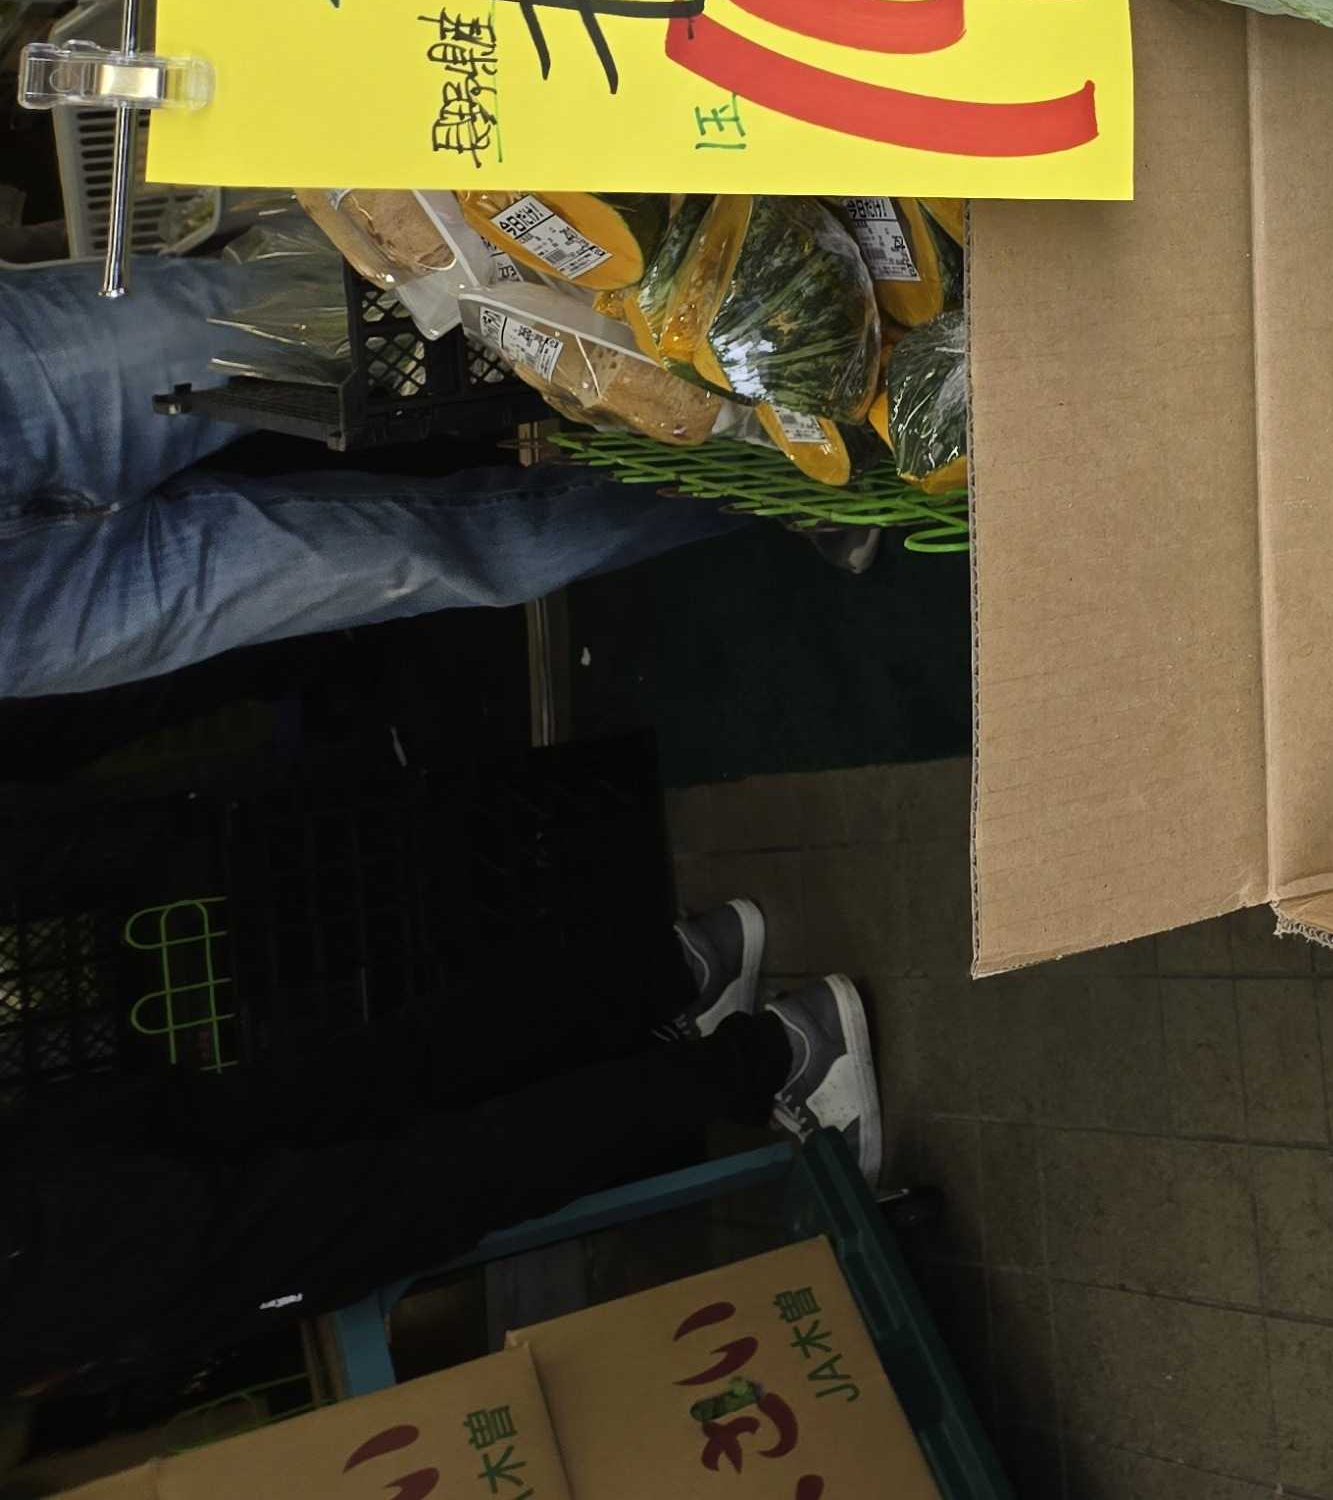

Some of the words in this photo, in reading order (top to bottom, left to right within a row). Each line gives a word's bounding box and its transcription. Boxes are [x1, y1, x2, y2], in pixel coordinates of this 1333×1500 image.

[672, 1299, 825, 1499] さい
[772, 1285, 861, 1403] JA木曽
[461, 1403, 537, 1499] 木曽
